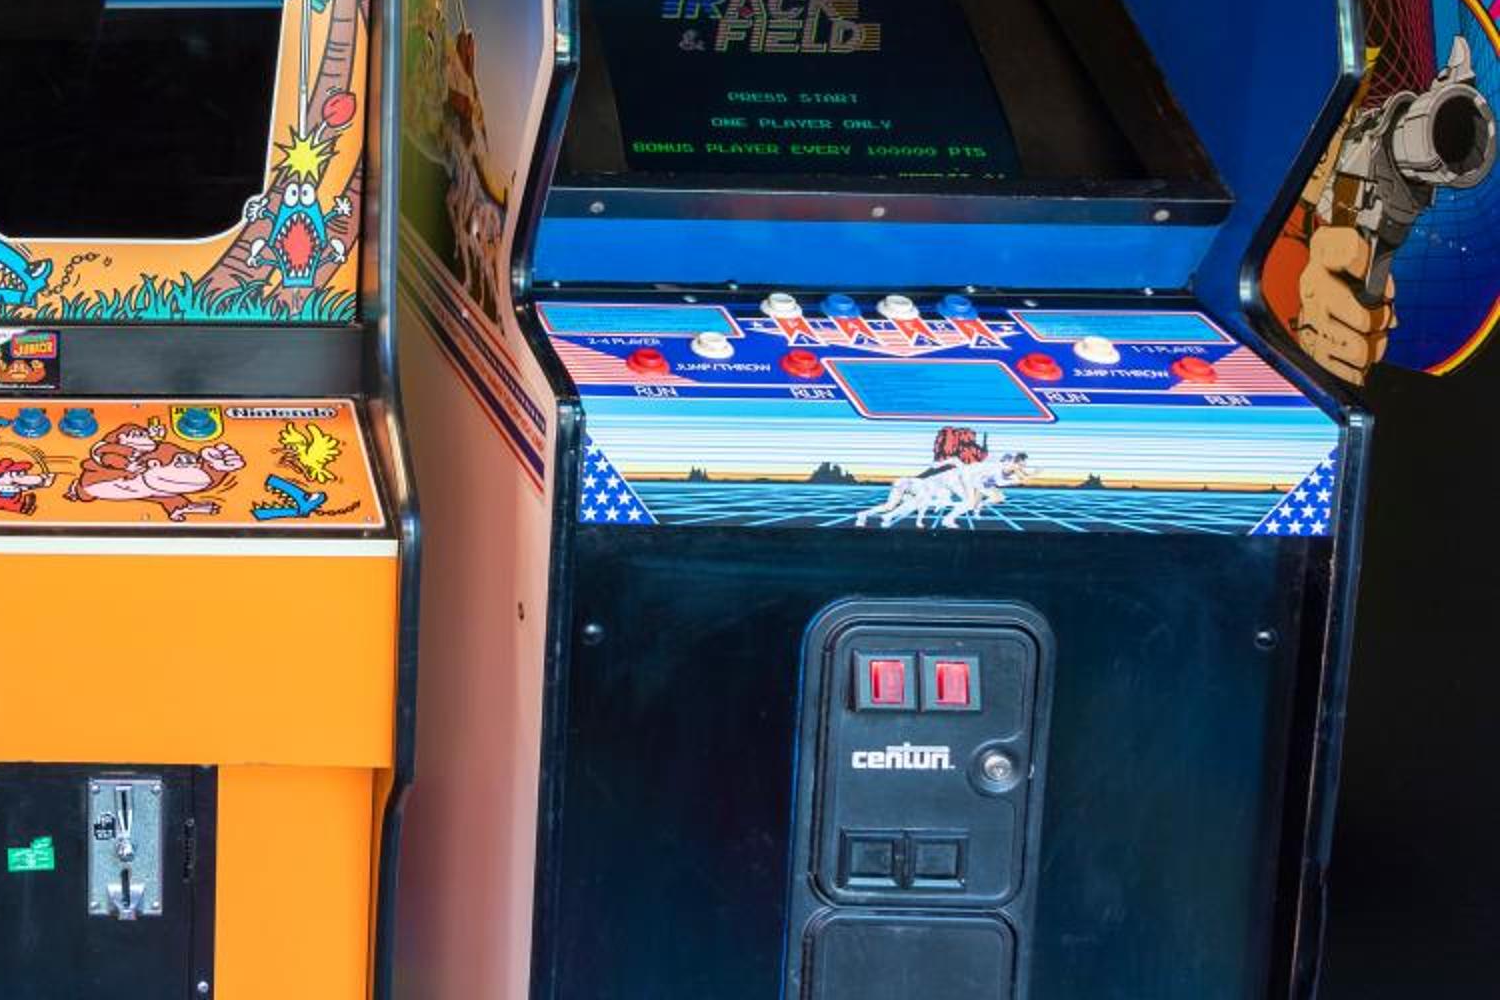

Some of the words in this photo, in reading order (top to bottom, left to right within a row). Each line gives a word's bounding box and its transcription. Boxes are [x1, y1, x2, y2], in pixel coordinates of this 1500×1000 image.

[713, 17, 881, 53] FIELD
[727, 91, 788, 103] PRESS
[799, 93, 859, 104] START
[711, 117, 748, 127] ONE
[759, 118, 834, 129] PLAYER
[842, 119, 893, 130] ONLY
[632, 142, 695, 153] BONUS
[706, 143, 780, 154] PLAYER
[790, 144, 852, 155] EVERY
[947, 147, 988, 158] PTS
[634, 386, 679, 397] RUN
[792, 387, 835, 399] RUN
[1045, 391, 1092, 403] RUN
[1203, 394, 1252, 405] RUN
[232, 404, 335, 418] Nintendo
